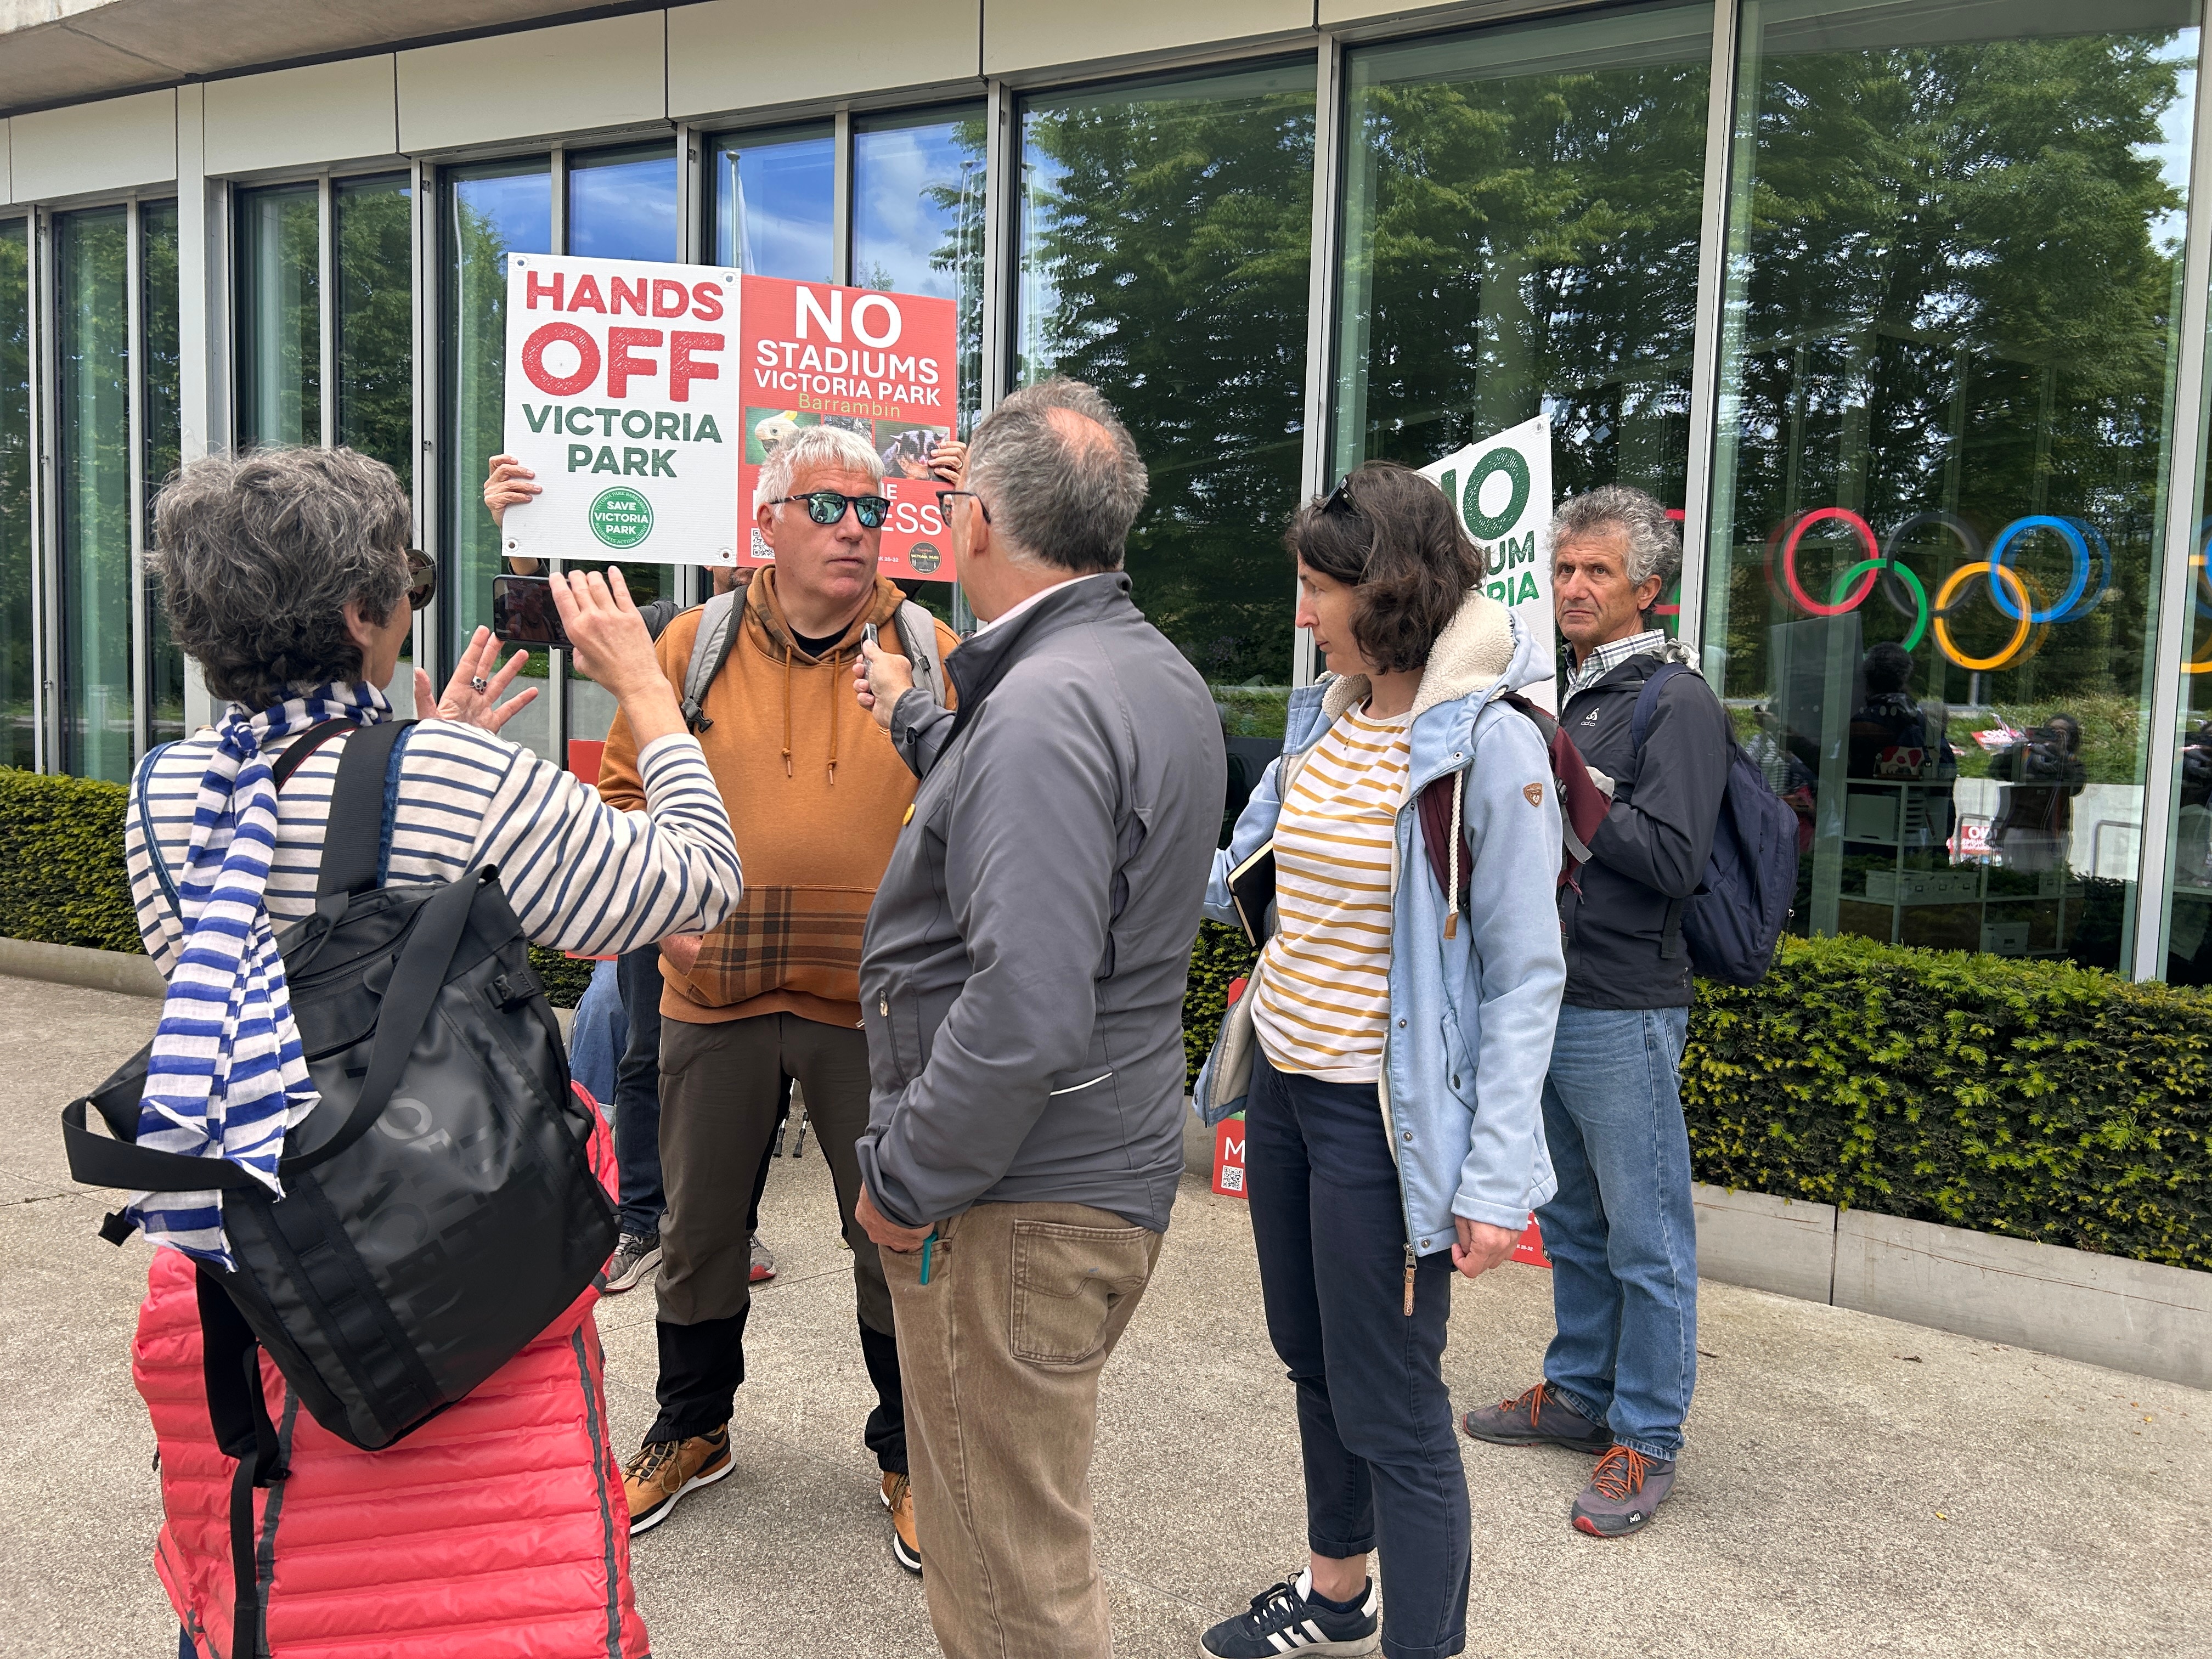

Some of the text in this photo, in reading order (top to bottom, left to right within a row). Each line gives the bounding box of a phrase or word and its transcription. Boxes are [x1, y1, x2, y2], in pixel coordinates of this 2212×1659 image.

[527, 271, 723, 321] HANDS
[796, 285, 902, 348] NO
[522, 322, 725, 402] OFF
[757, 339, 939, 384] STADIUMS
[754, 368, 941, 407] VICTORIA PARK
[522, 404, 723, 443] VICTORIA
[799, 393, 901, 419] Barrambin
[568, 444, 677, 477] PARK
[594, 512, 648, 523] VICTORIA
[595, 494, 612, 511] VICTORIA
[607, 501, 636, 511] SAVE
[606, 525, 636, 534] PARK
